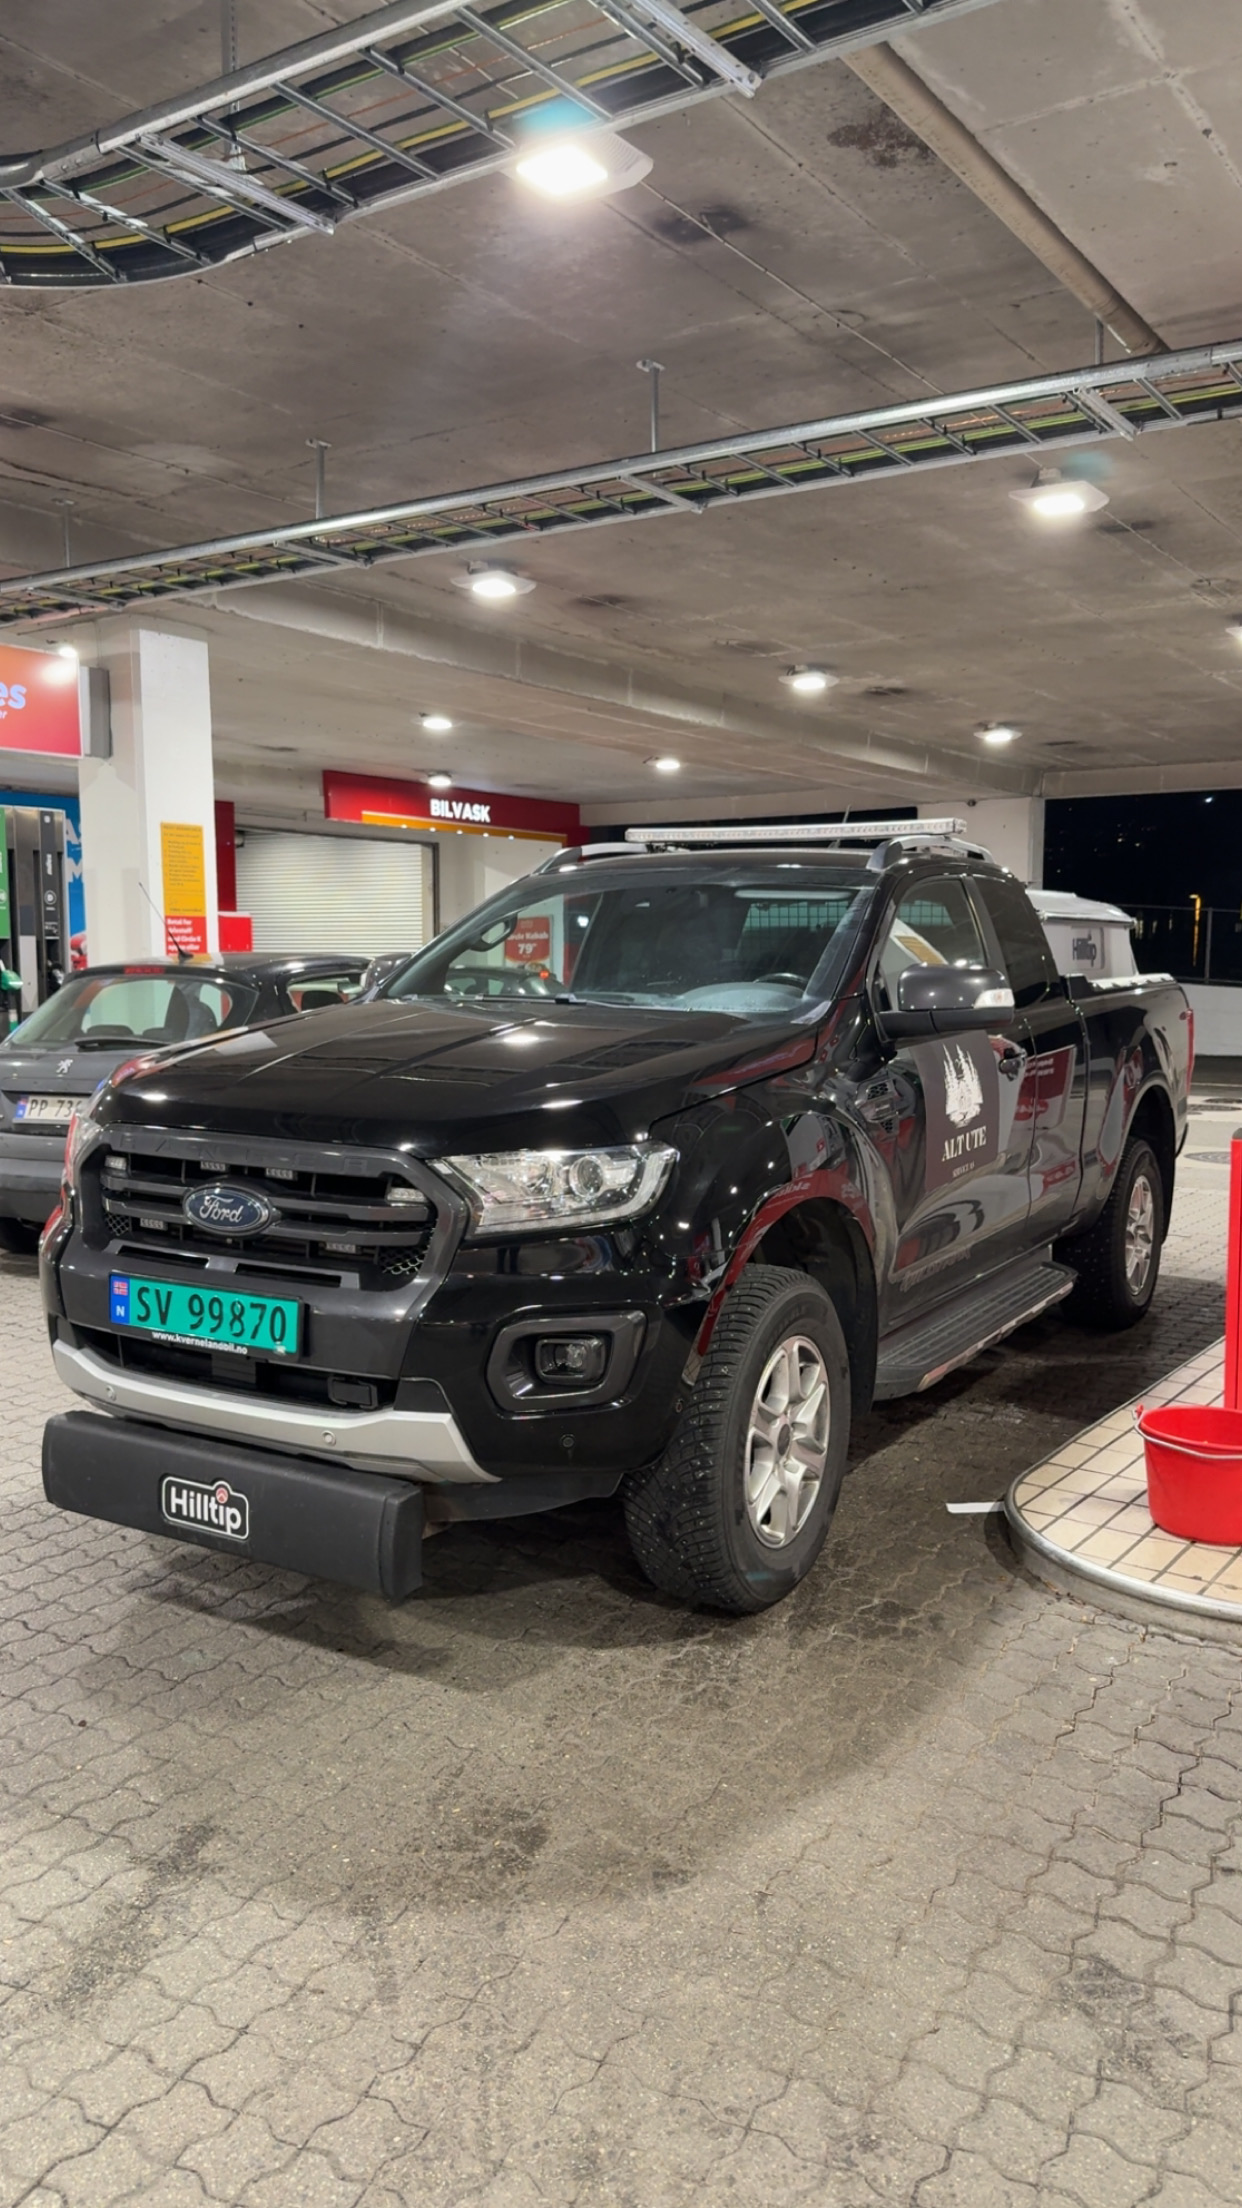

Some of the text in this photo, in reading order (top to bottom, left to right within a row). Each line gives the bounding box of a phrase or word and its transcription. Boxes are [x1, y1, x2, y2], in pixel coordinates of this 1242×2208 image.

[430, 798, 491, 823] BILVASK
[1072, 936, 1097, 968] Hilltip
[29, 1098, 82, 1118] PP 73
[941, 1125, 987, 1162] ALT UTE
[199, 1195, 244, 1224] Ford
[116, 1286, 287, 1343] N SV 99870
[151, 1330, 248, 1355] www.kvernelandbil.no
[170, 1486, 242, 1535] Hilltip
